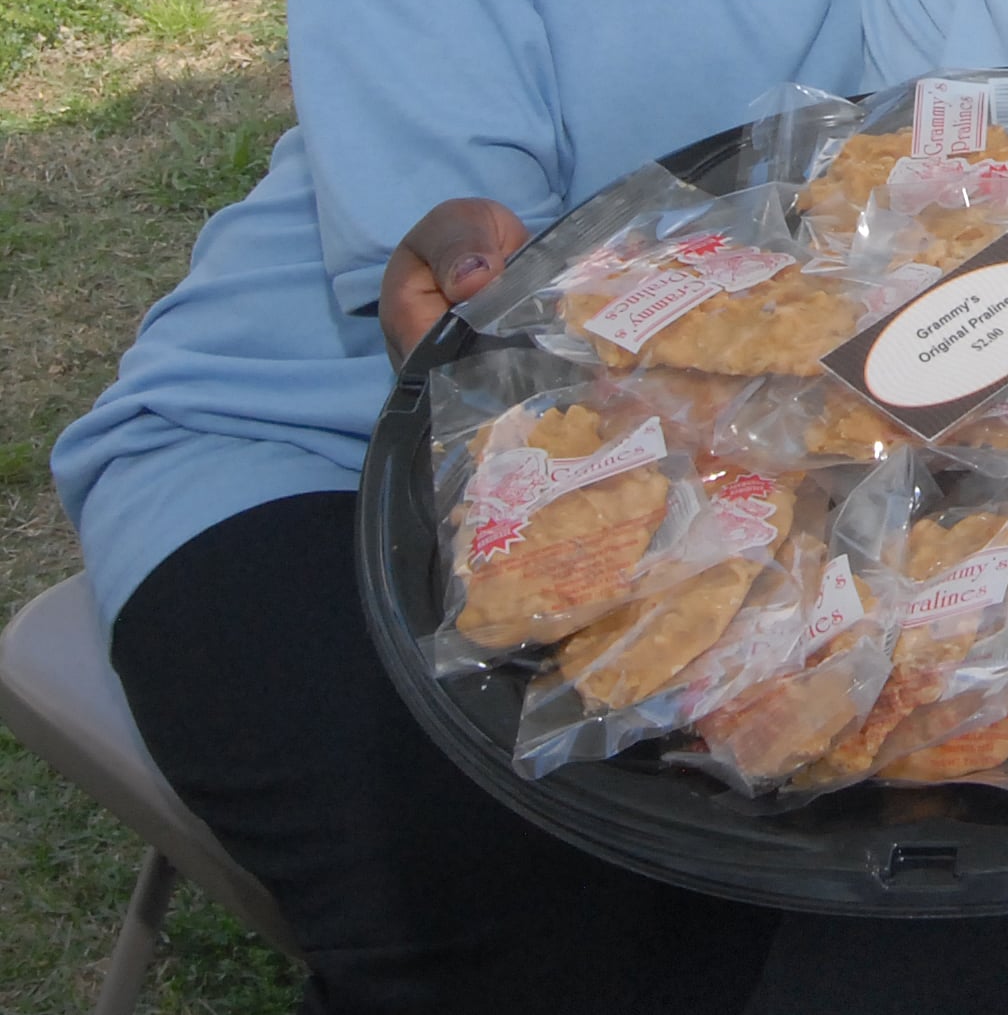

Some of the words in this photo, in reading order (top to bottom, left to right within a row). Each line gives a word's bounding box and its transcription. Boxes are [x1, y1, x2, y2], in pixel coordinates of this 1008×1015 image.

[923, 82, 948, 157] Grammy's
[951, 95, 974, 155] Pralines
[614, 280, 706, 339] Grammy's
[916, 294, 981, 340] Grammy's
[918, 326, 970, 364] Original
[971, 327, 1005, 353] $2.00
